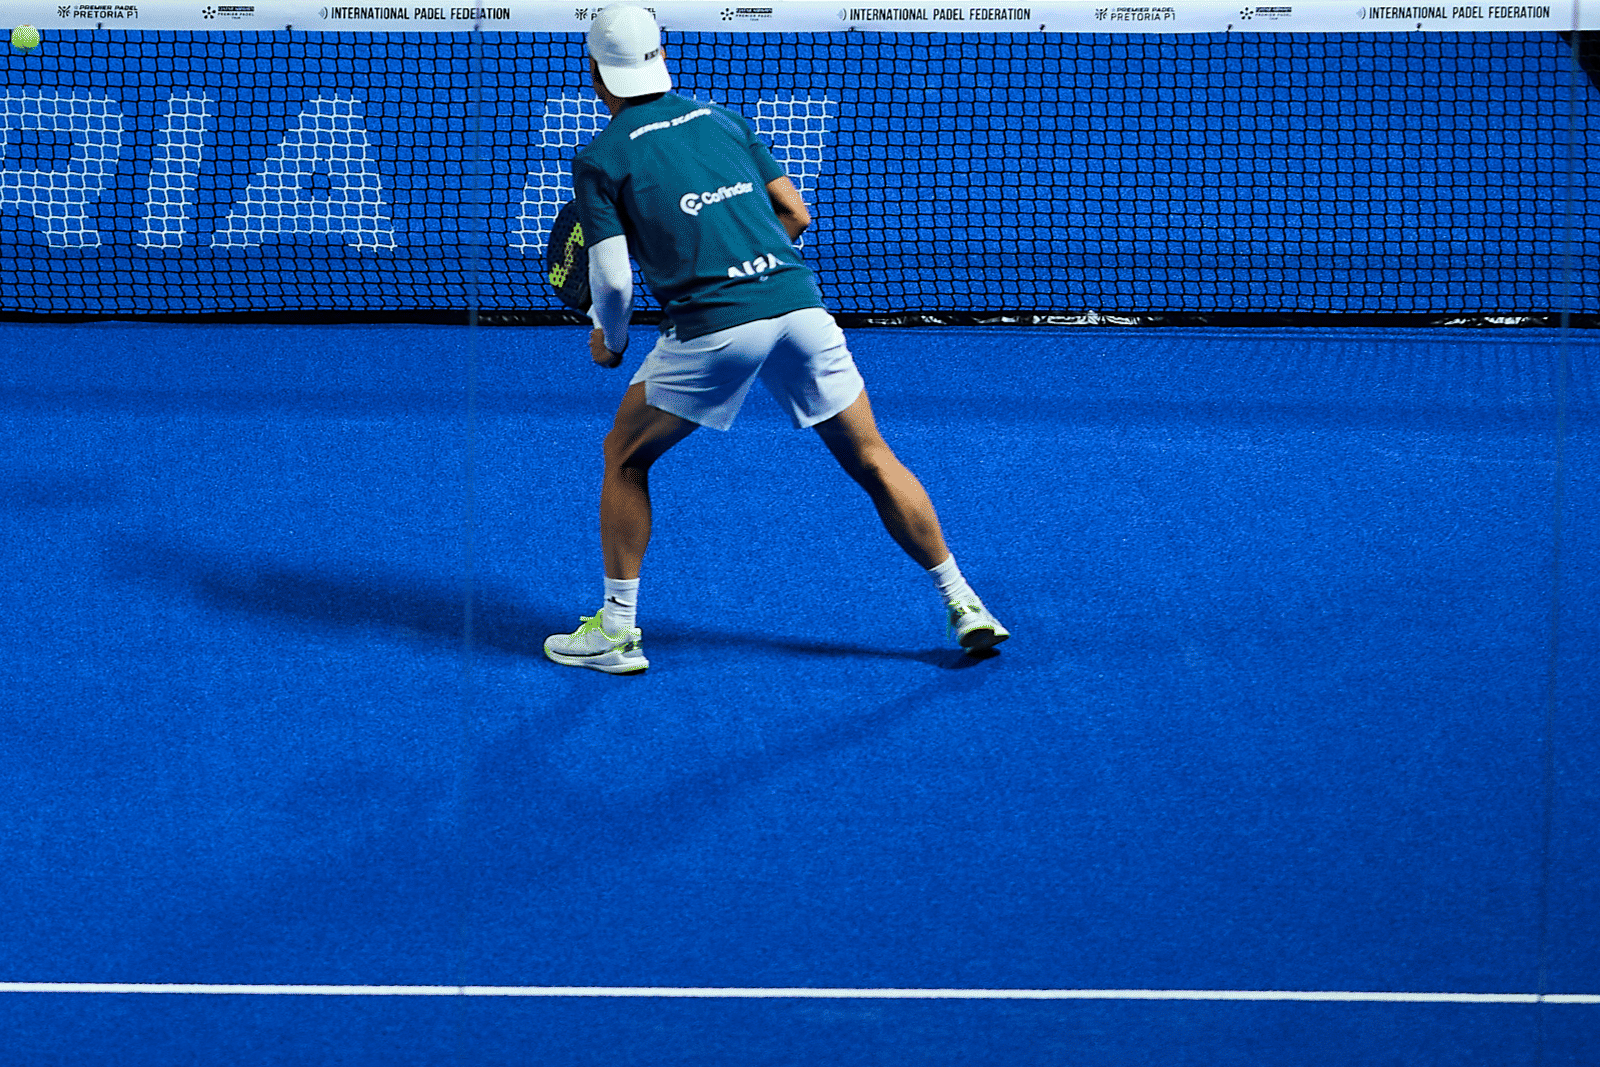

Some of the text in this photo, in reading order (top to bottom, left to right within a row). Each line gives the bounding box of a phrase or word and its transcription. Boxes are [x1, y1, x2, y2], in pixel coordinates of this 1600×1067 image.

[74, 10, 138, 19] PRETORIA P1
[332, 7, 409, 19] INTERNATIONAL
[415, 8, 446, 19] PADEL
[851, 8, 1030, 20] INTERNATIONAL PADEL FEDERATION
[1110, 12, 1176, 21] PRETORIA P1
[1370, 6, 1549, 19] INTERNATIONAL PADEL FEDERATION
